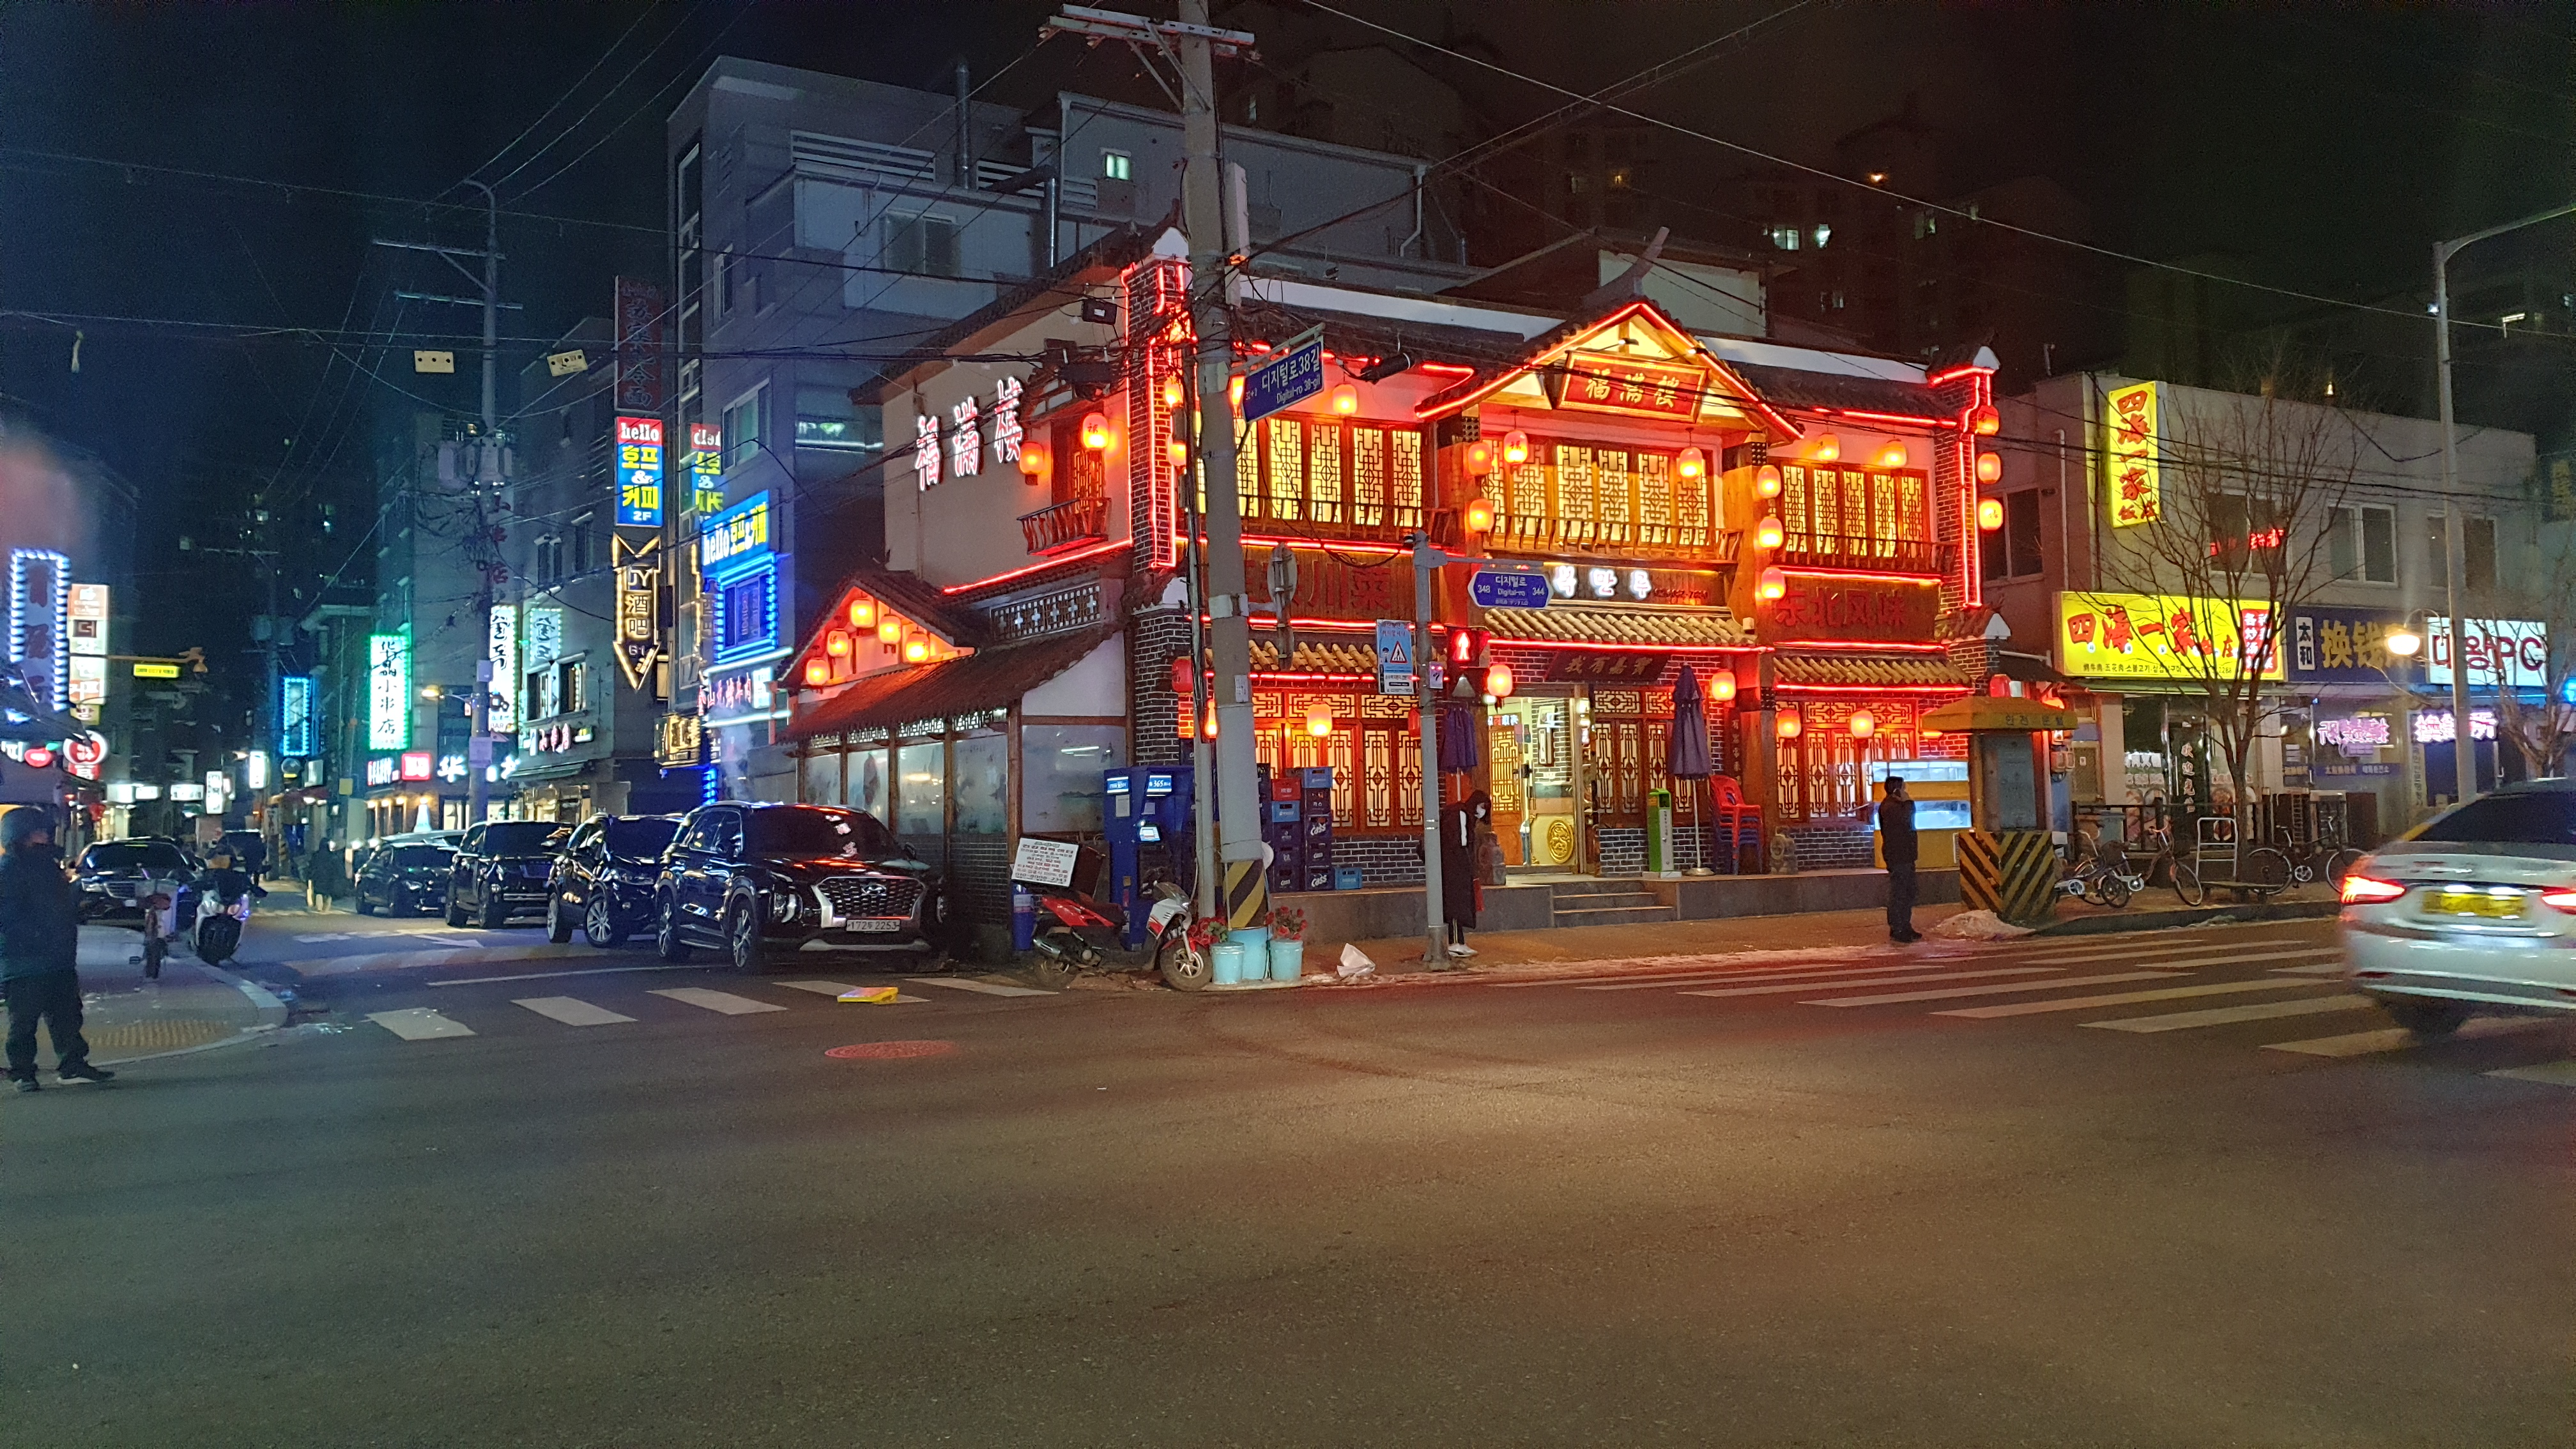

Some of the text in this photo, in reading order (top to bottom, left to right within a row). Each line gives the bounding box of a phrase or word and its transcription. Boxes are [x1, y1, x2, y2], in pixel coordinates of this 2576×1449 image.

[1262, 346, 1320, 392] 디지털로38길
[1276, 374, 1321, 404] Digital-ro 38-gil
[620, 422, 659, 441] hello
[622, 445, 658, 470] 호프
[631, 470, 654, 484] &
[622, 485, 659, 509] 커피
[633, 512, 652, 521] 2F
[703, 523, 729, 566] hello
[1495, 575, 1528, 587] 디지털로
[1498, 588, 1526, 597] Digital-ro
[1532, 586, 1545, 595] 344
[1555, 566, 1651, 599] 복만루
[626, 595, 650, 636] 酒吧
[1775, 586, 1905, 627] 东北风味
[2298, 622, 2312, 665] 太和
